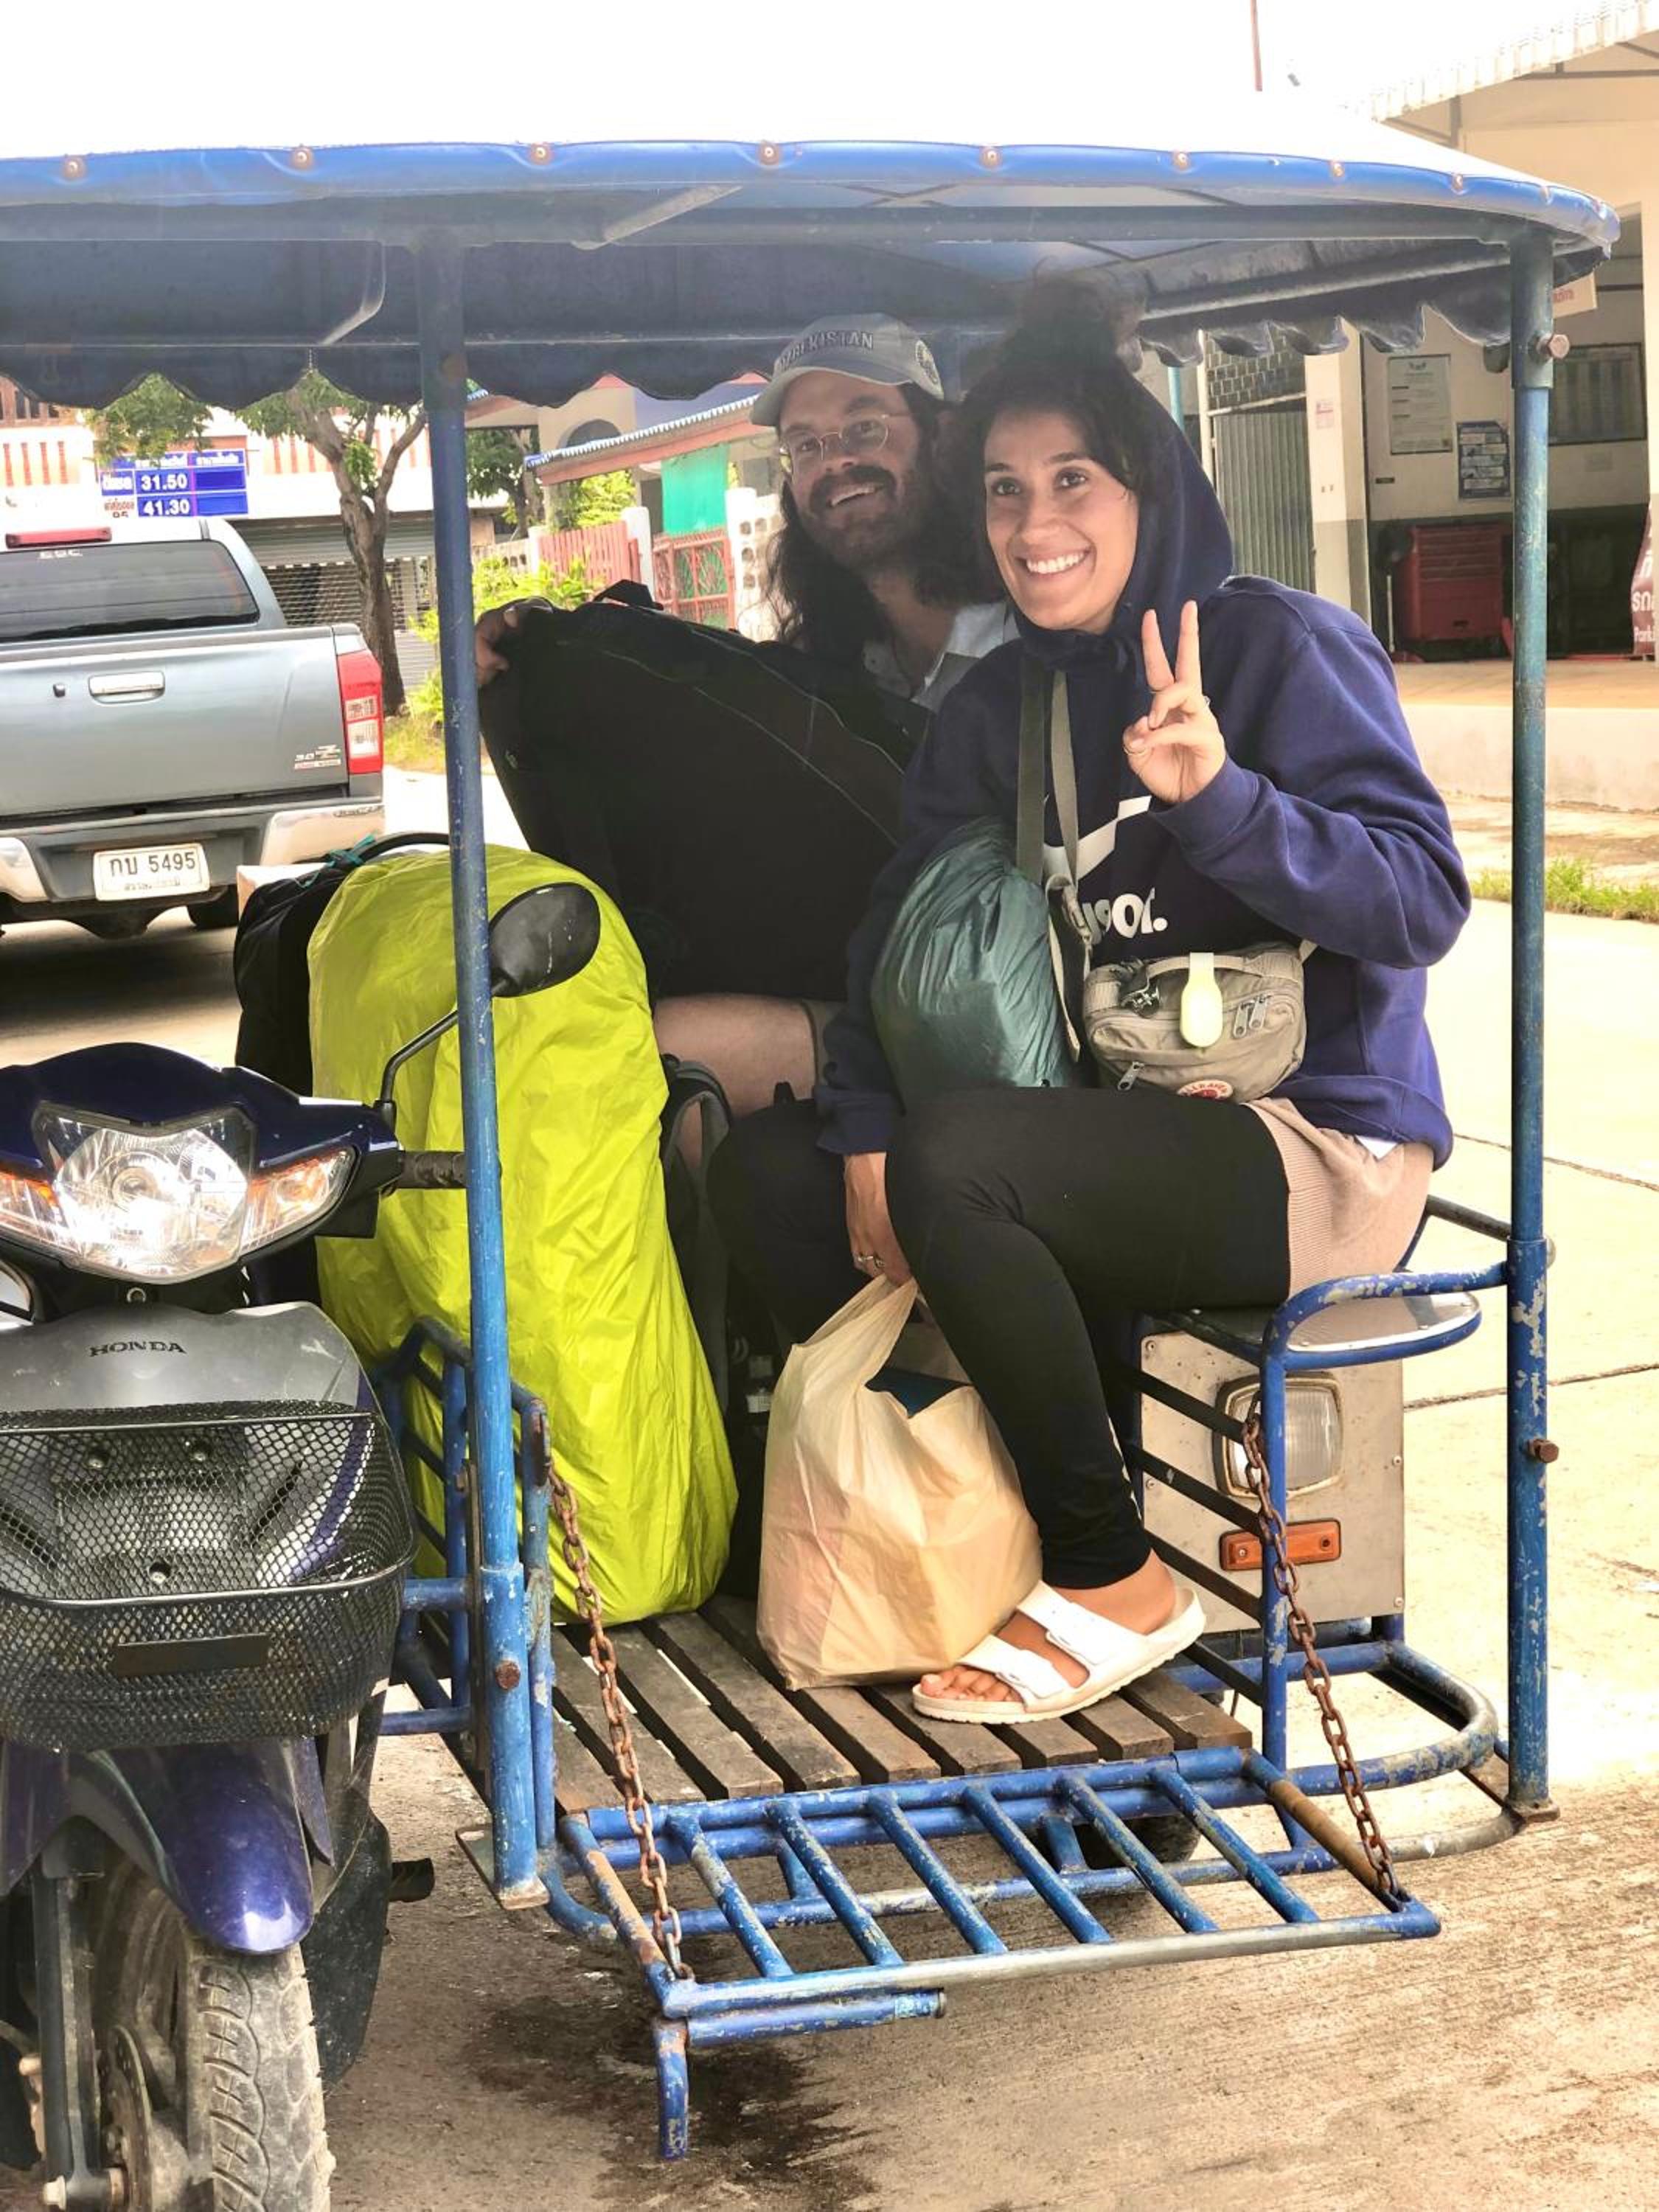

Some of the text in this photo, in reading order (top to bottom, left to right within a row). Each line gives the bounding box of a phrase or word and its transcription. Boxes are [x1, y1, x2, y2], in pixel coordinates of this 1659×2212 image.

[141, 473, 187, 490] 31.50
[143, 499, 190, 516] 41.30
[148, 852, 196, 873] 5495
[89, 1340, 187, 1357] HONDA
